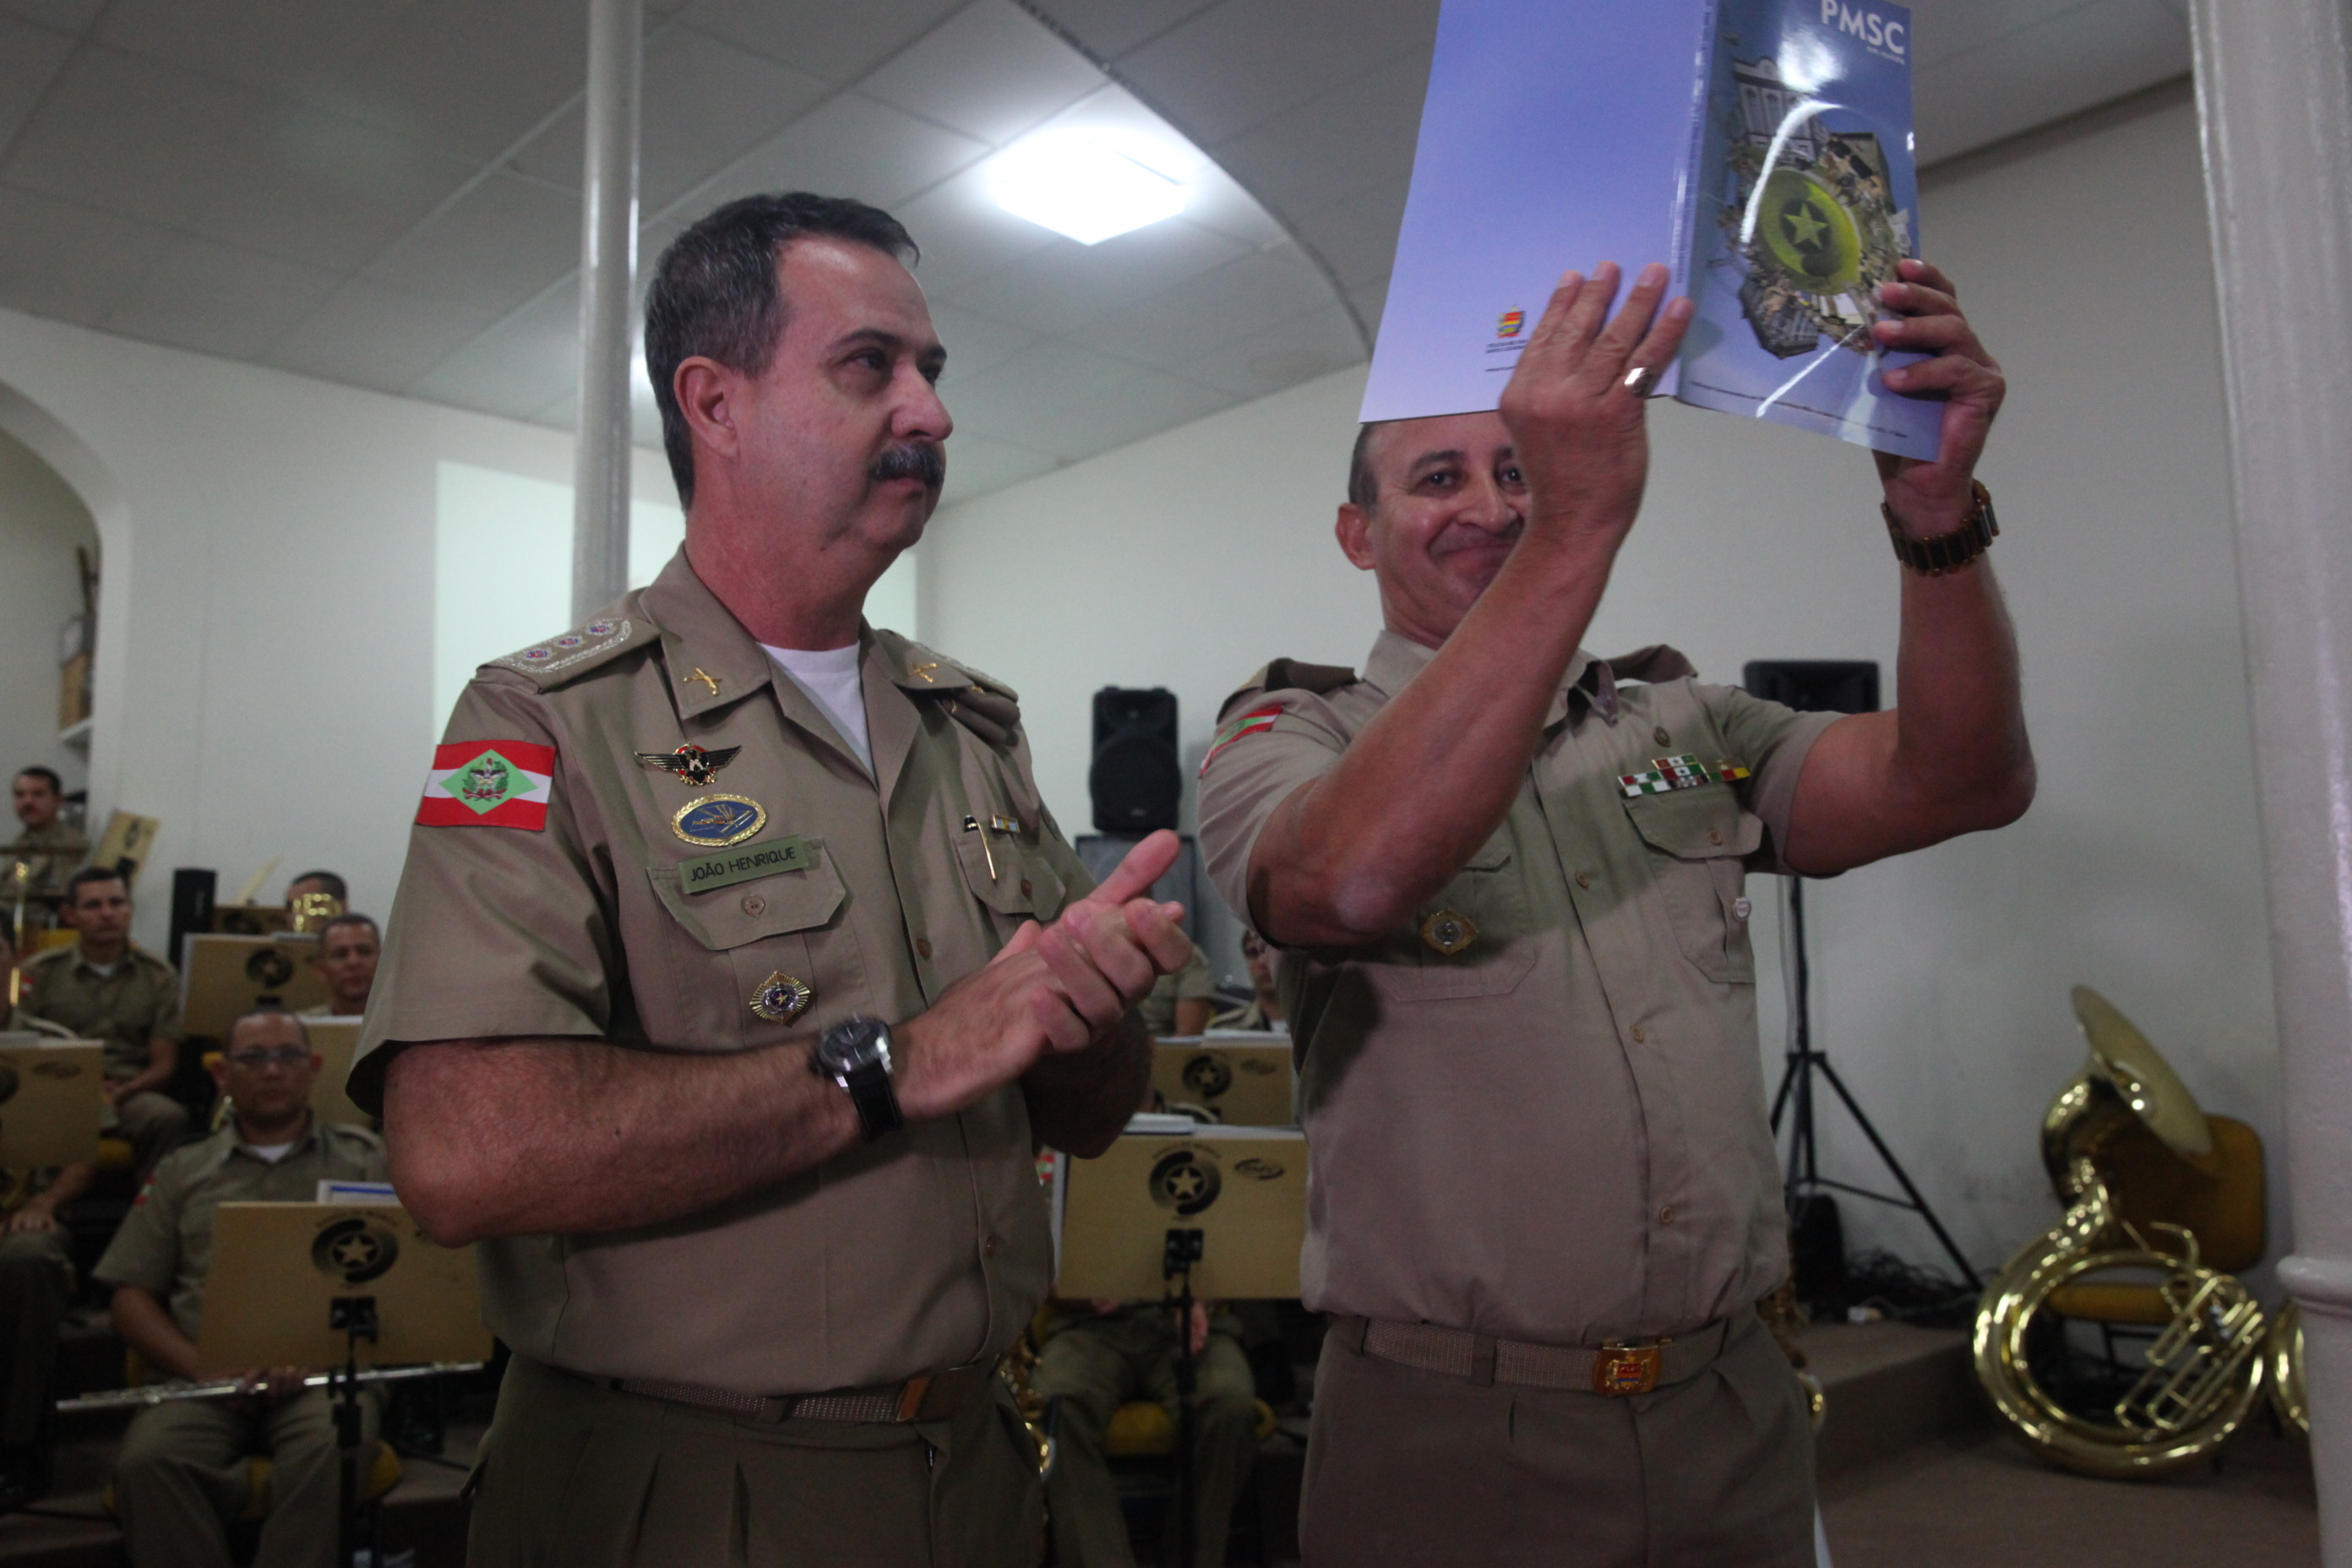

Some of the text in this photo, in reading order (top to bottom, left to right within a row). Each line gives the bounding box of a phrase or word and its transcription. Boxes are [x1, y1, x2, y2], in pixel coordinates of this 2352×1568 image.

[1821, 0, 1904, 55] PMSC
[690, 847, 796, 882] JOÃO HENRIQUE
